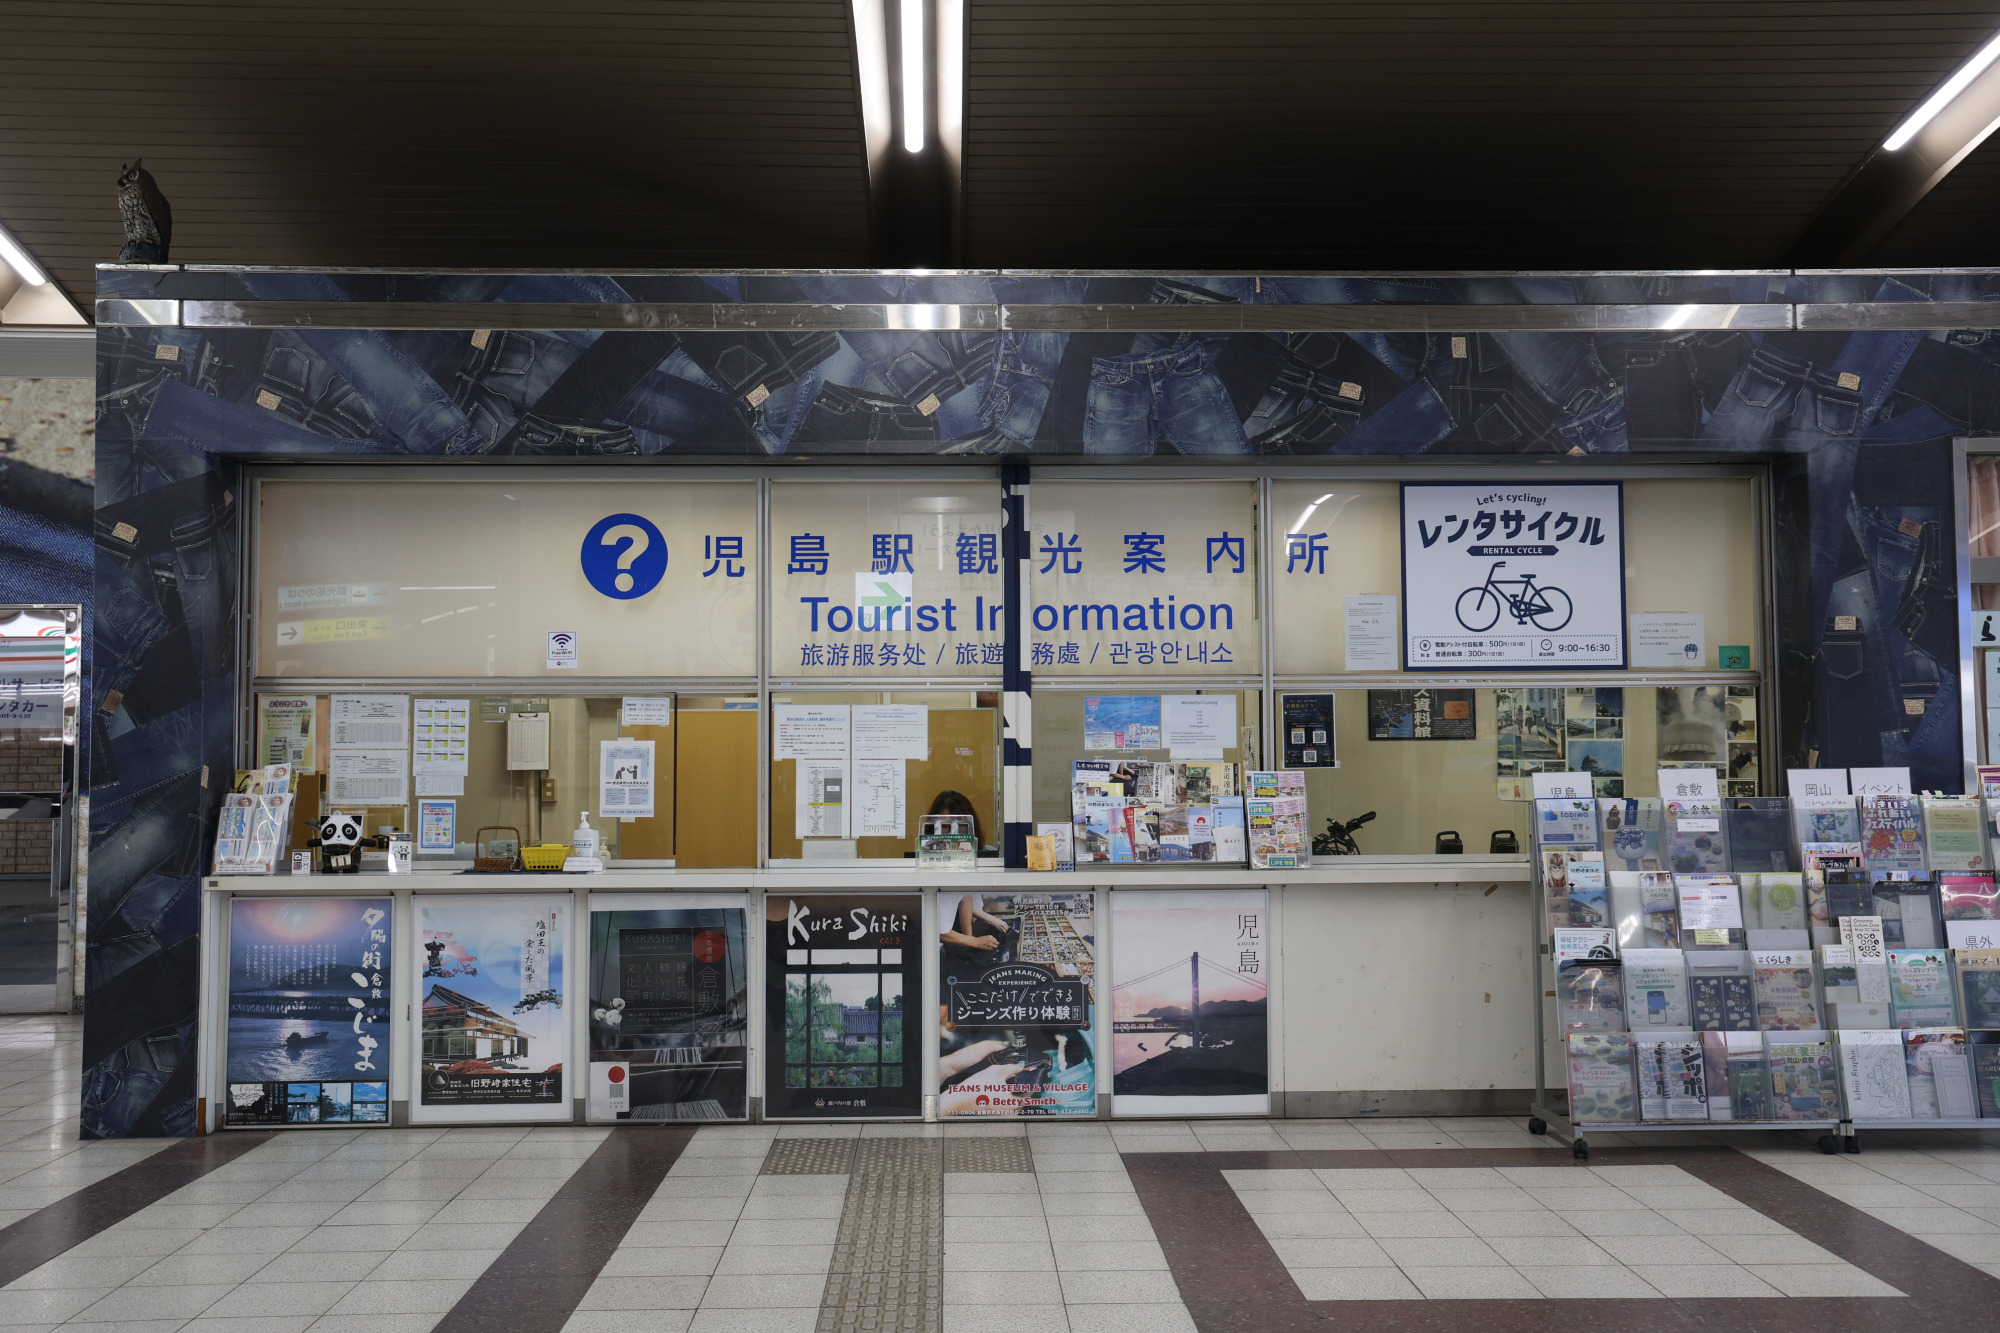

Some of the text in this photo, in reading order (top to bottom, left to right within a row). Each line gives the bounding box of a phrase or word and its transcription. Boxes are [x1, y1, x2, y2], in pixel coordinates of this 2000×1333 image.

[1506, 493, 1547, 506] cycling!
[1417, 509, 1606, 549] レンタサイクル
[702, 532, 1329, 578] 児島駅観光案内所
[1483, 547, 1543, 555] RENTAL CYCLE
[800, 595, 1233, 633] Tourist Inormation
[801, 642, 927, 667] 旅游服务处
[955, 641, 1081, 666] 旅遊務處
[1109, 641, 1234, 665] 관광안내소
[1675, 782, 1704, 797] 倉敷
[1805, 783, 1832, 797] 岡山
[1858, 783, 1905, 795] イベント
[1865, 818, 1918, 830] フェスティバル
[787, 900, 908, 946] Kura Shiki
[536, 919, 547, 955] 塩田王の
[624, 933, 686, 945] KURASHIKI
[1237, 914, 1260, 975] 児島
[1559, 936, 1595, 944] 福祉タクシー
[1965, 934, 1994, 949] 県外
[524, 938, 535, 984] 愛した風景
[1765, 955, 1793, 965] くらしき
[370, 972, 384, 1000] 倉敷
[625, 962, 638, 989] 文化
[659, 961, 671, 1001] 紡いだ
[676, 961, 688, 1001] 綿花の
[988, 968, 1048, 985] JEANS MAKING
[697, 965, 722, 1014] 倉敷
[966, 987, 1073, 1004] ここだけ でできる
[347, 971, 379, 1072] こじま
[957, 1005, 1072, 1020] ジーンズ作り体験
[1849, 1047, 1862, 1102] kibiji graphic
[948, 1083, 1089, 1095] JEANS MUSEUM & VILLAGE
[853, 1099, 867, 1108] 倉敷
